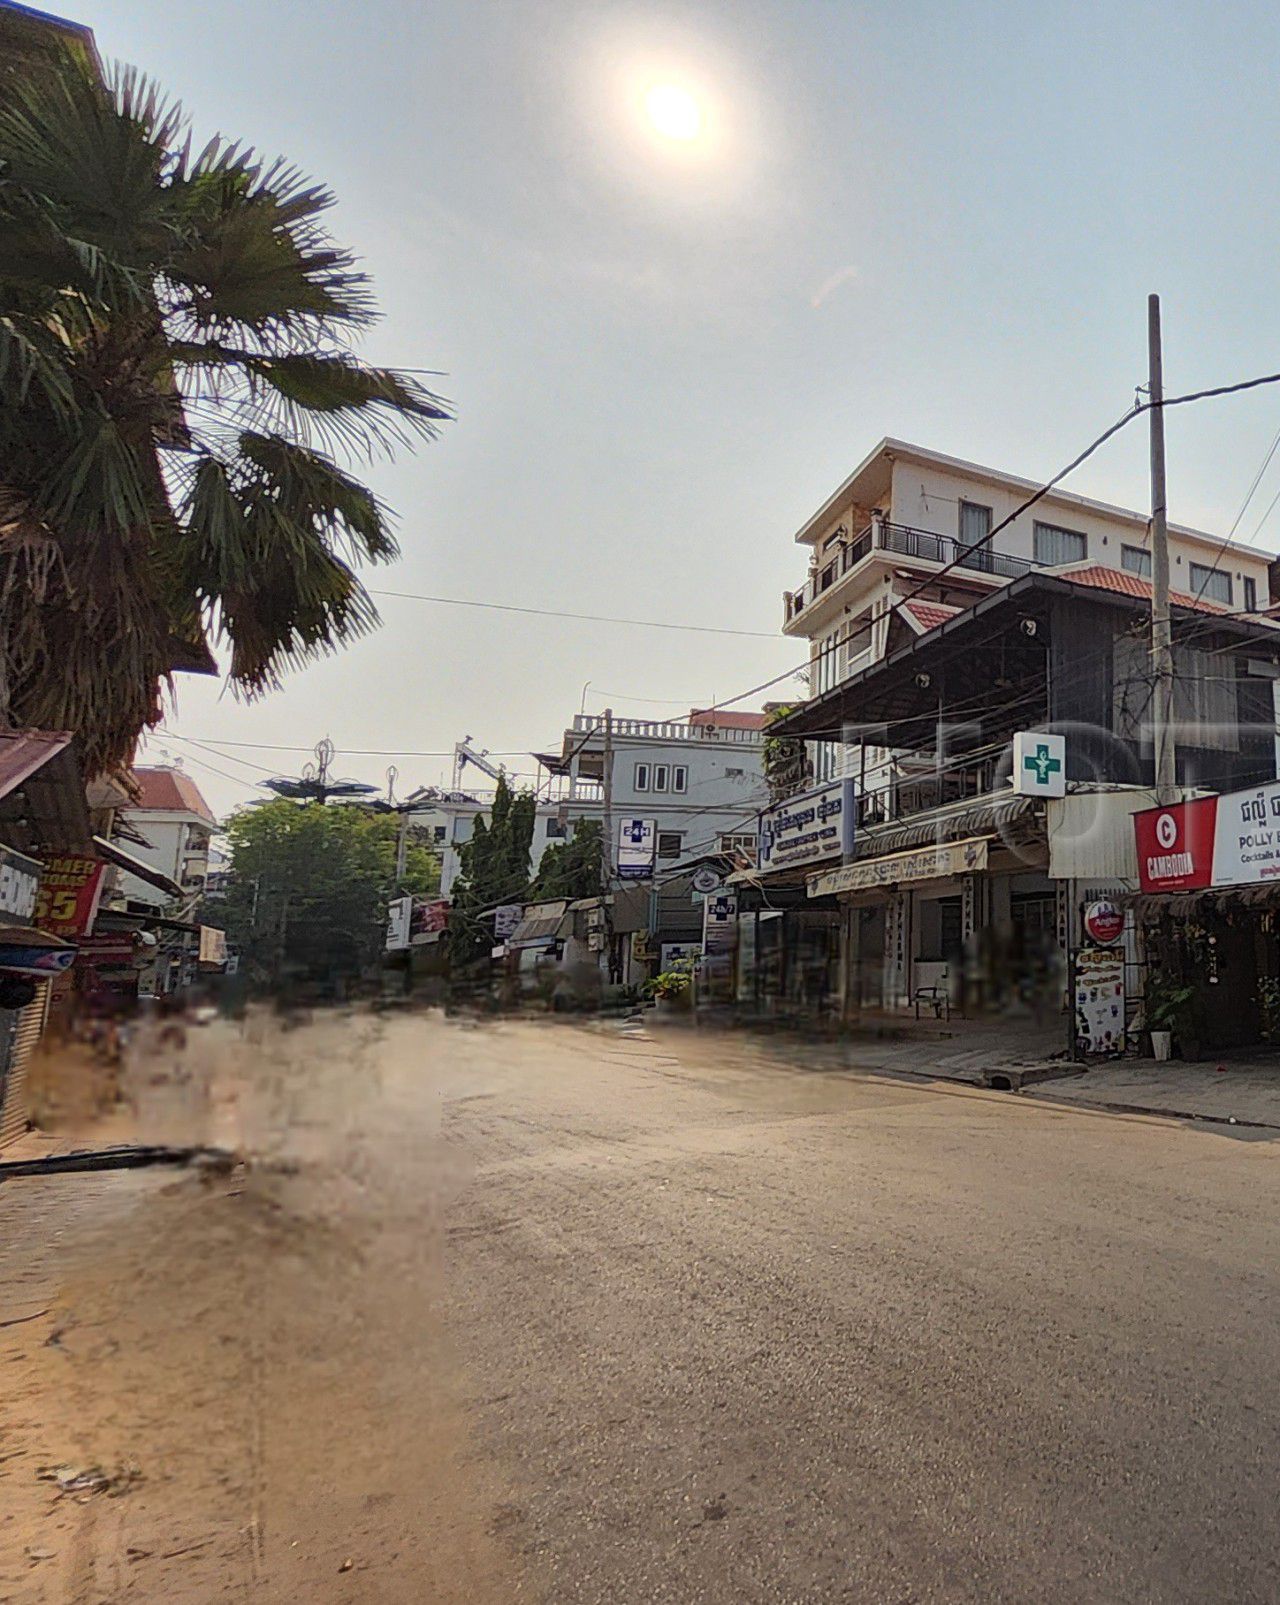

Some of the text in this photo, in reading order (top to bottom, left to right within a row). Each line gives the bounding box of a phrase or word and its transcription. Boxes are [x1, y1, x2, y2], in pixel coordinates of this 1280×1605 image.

[624, 827, 650, 836] 24H
[1239, 832, 1273, 850] POLLY
[1147, 852, 1194, 880] CAMBODIA
